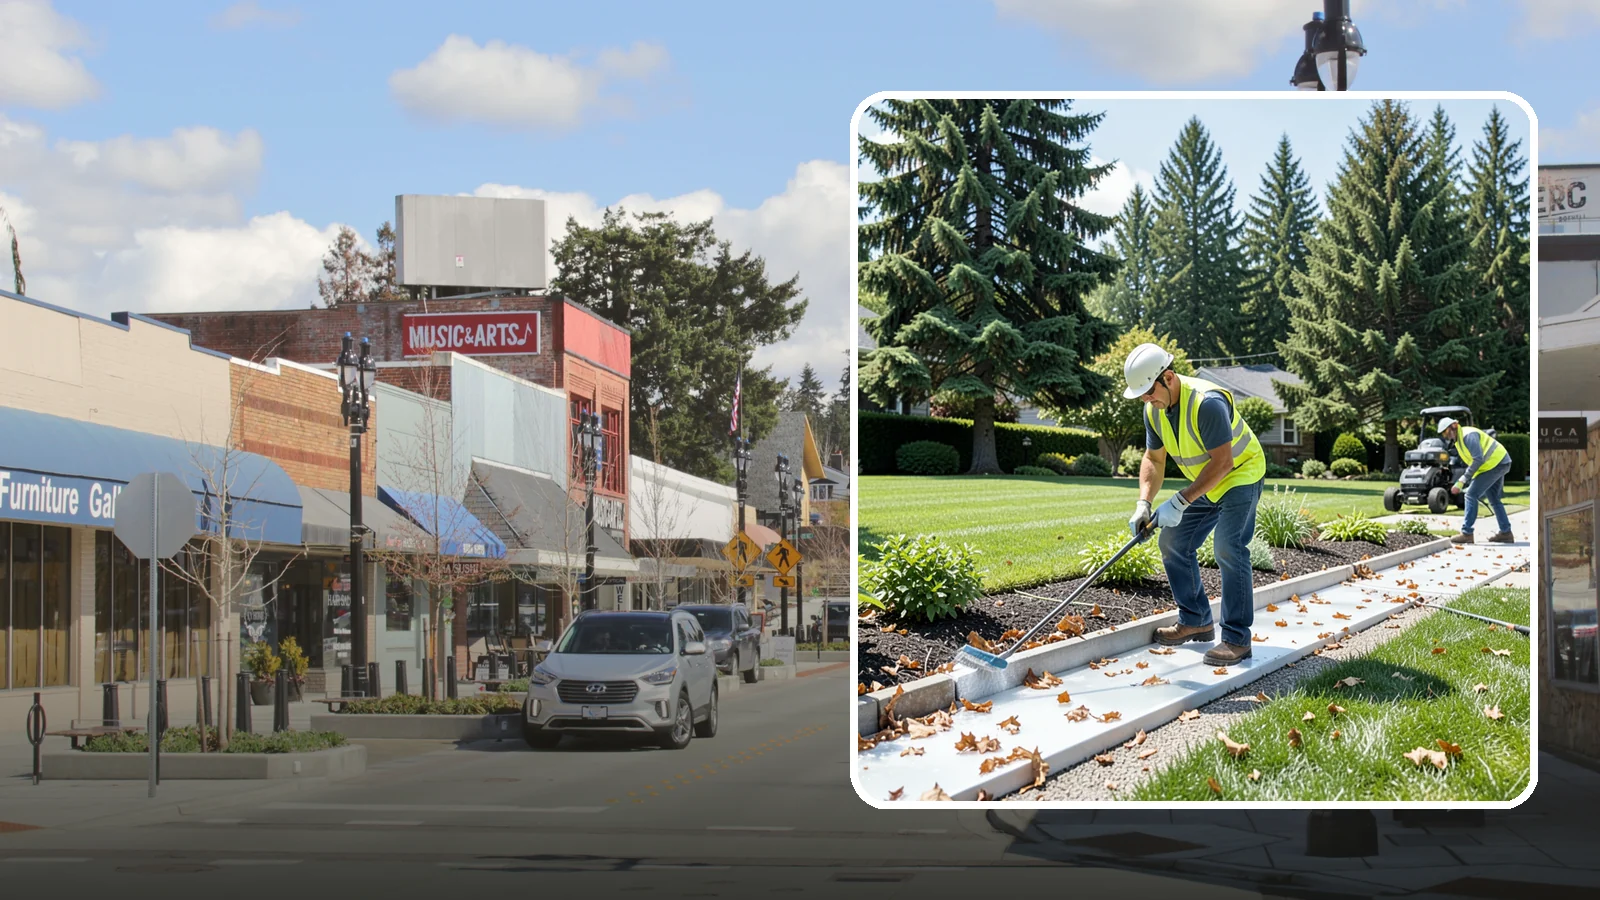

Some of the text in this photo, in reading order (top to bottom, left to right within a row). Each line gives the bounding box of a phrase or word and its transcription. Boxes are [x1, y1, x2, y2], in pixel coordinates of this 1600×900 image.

[409, 323, 519, 348] MUSIC&ARTS
[0, 471, 121, 519] Furniture Gal
